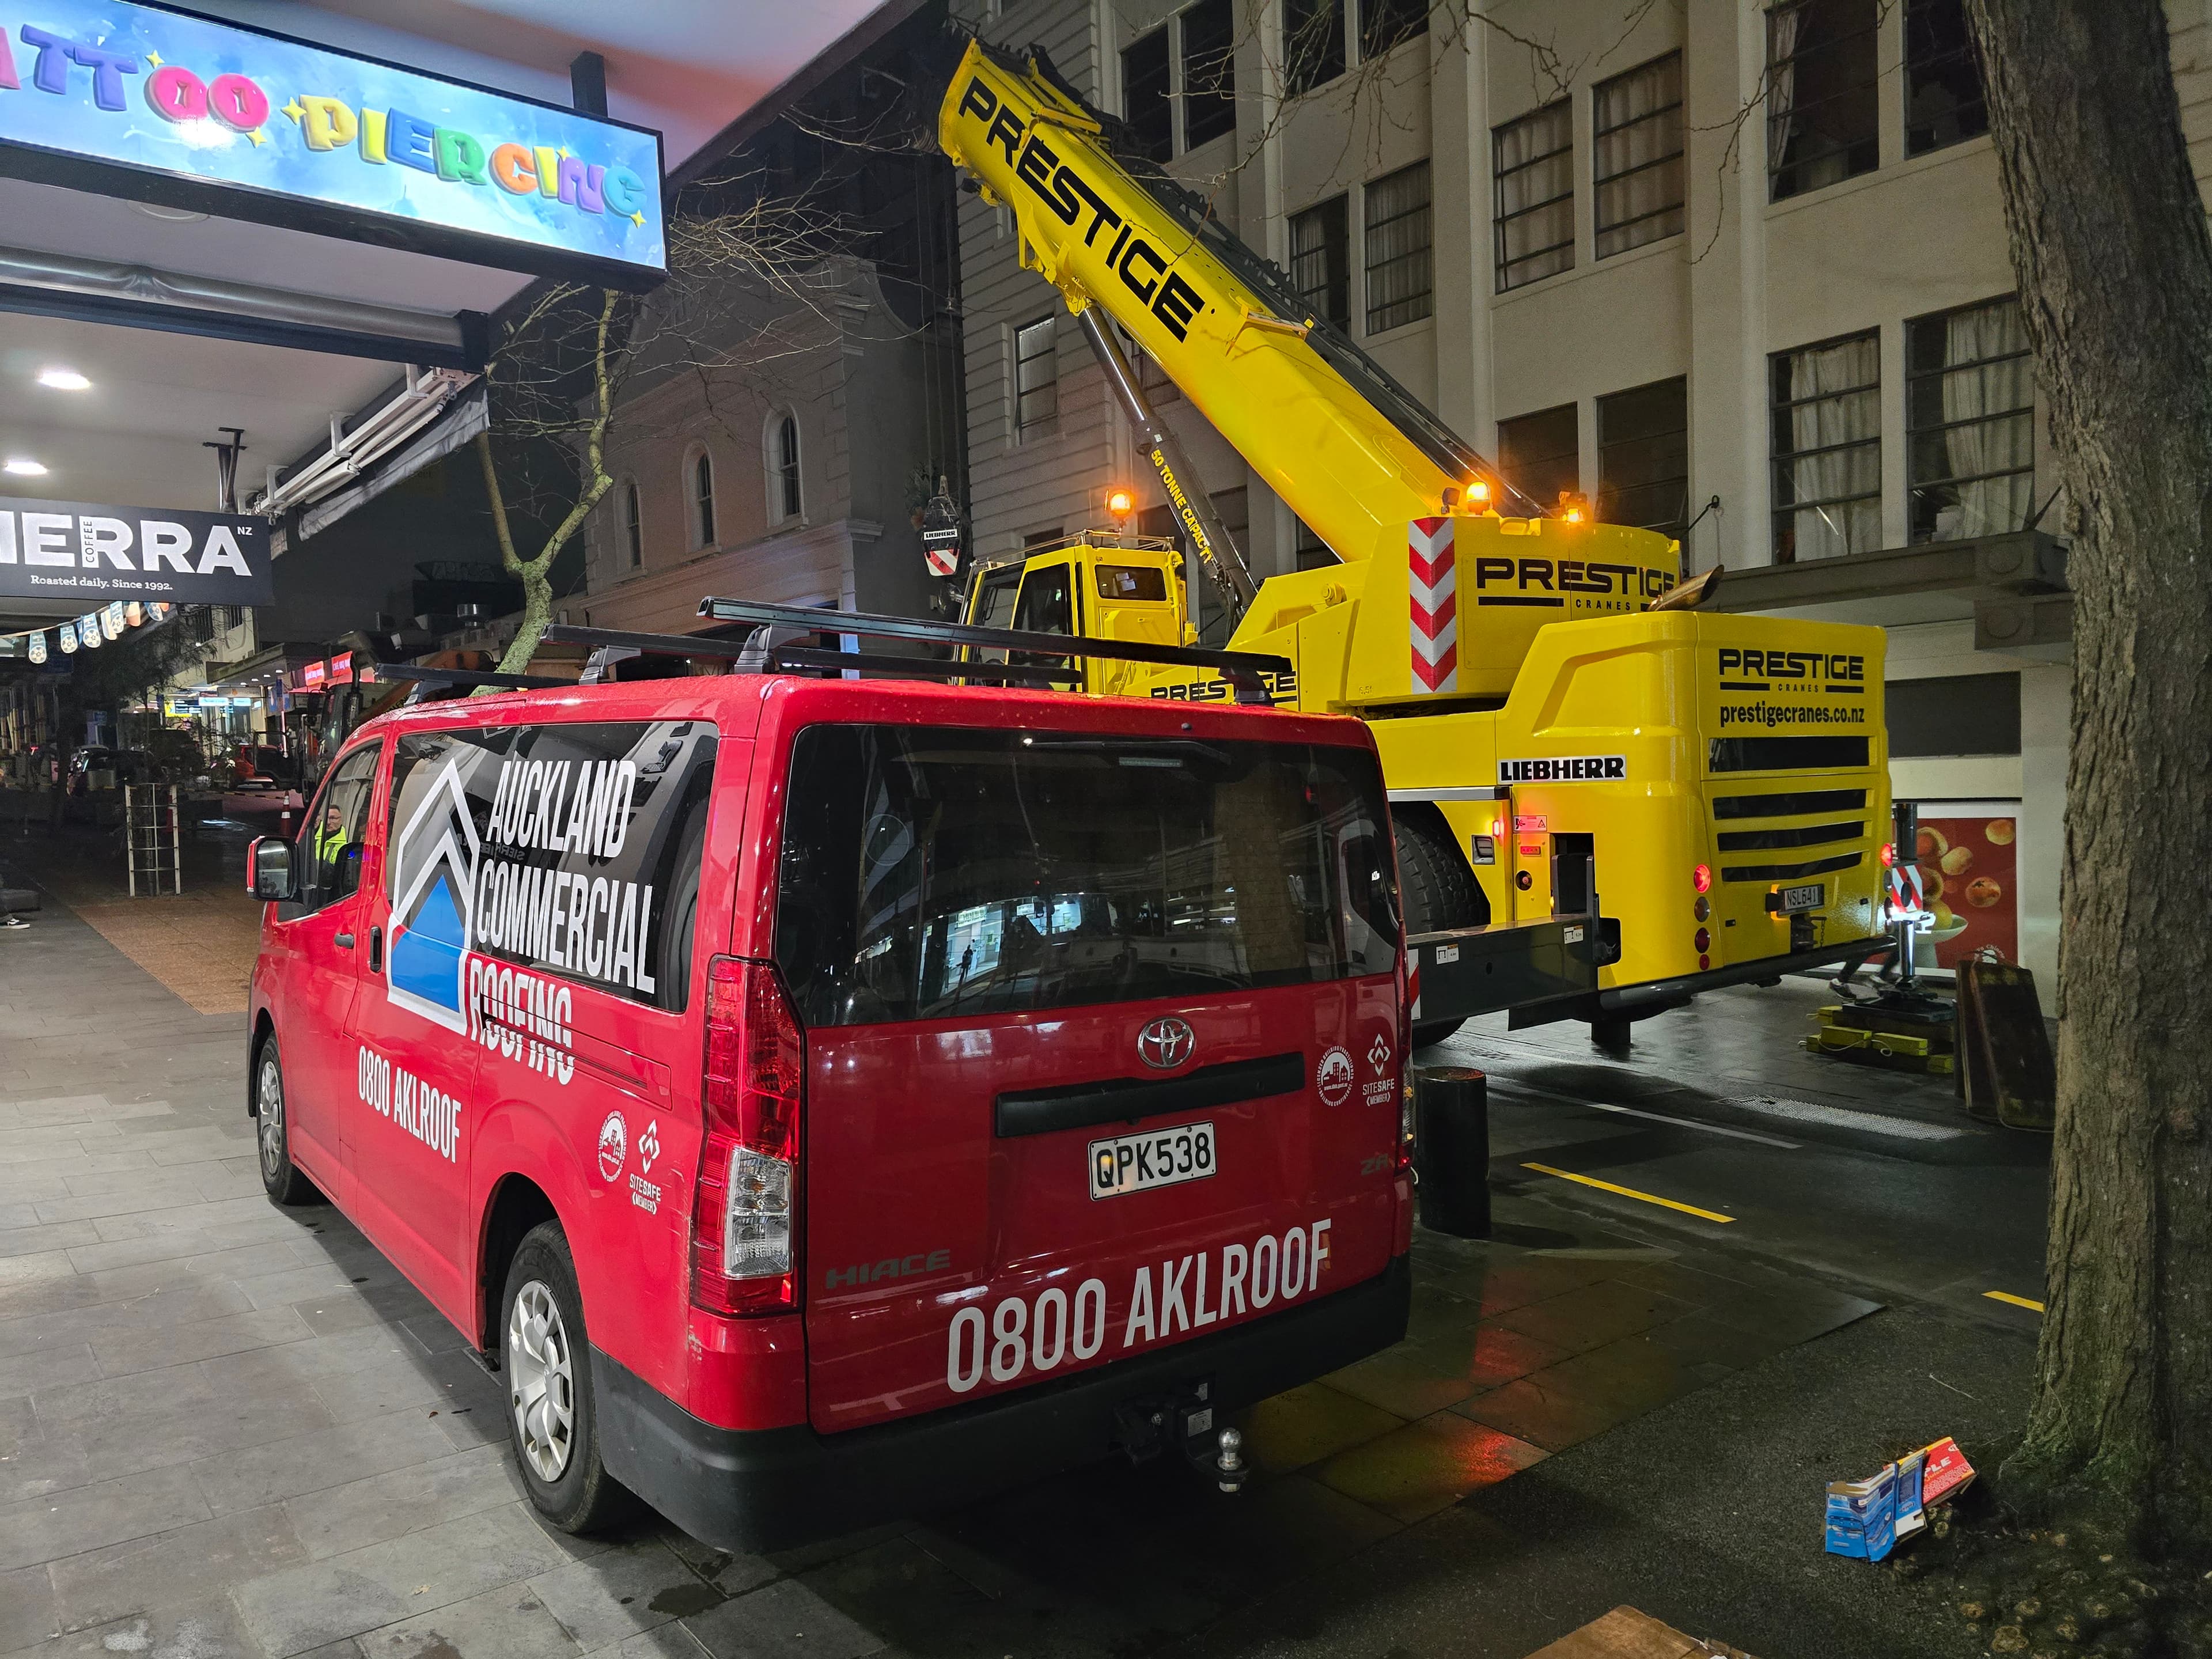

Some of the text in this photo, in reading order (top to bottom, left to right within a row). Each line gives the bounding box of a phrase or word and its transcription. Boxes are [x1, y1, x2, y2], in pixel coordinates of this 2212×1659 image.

[299, 93, 646, 216] PIERCING
[959, 76, 1205, 343] PRESTIGE
[1151, 449, 1164, 467] 50
[1160, 465, 1187, 509] TONNE
[83, 520, 93, 563] COFFEE
[237, 527, 253, 535] NZ
[926, 531, 956, 539] LIEBHERR
[31, 575, 173, 591] Roasted daily. Since 1992.
[1575, 599, 1630, 611] CRANES
[1719, 648, 1864, 680] PRESTIGE
[1778, 683, 1819, 693] CRANES
[1720, 700, 1865, 728] prestigecranes.co.nz
[1501, 757, 1624, 781] LIEBHERR
[486, 759, 636, 857] AUCKLAND
[1787, 888, 1816, 906] NSL641
[476, 859, 655, 994] COMMERCIAL
[470, 958, 575, 1085] ROOFING
[359, 1046, 461, 1163] 0800 AKLROOF
[1096, 1131, 1211, 1189] QPK538
[826, 1249, 950, 1289] HIACE
[947, 1218, 1331, 1392] 0800 AKLROOF
